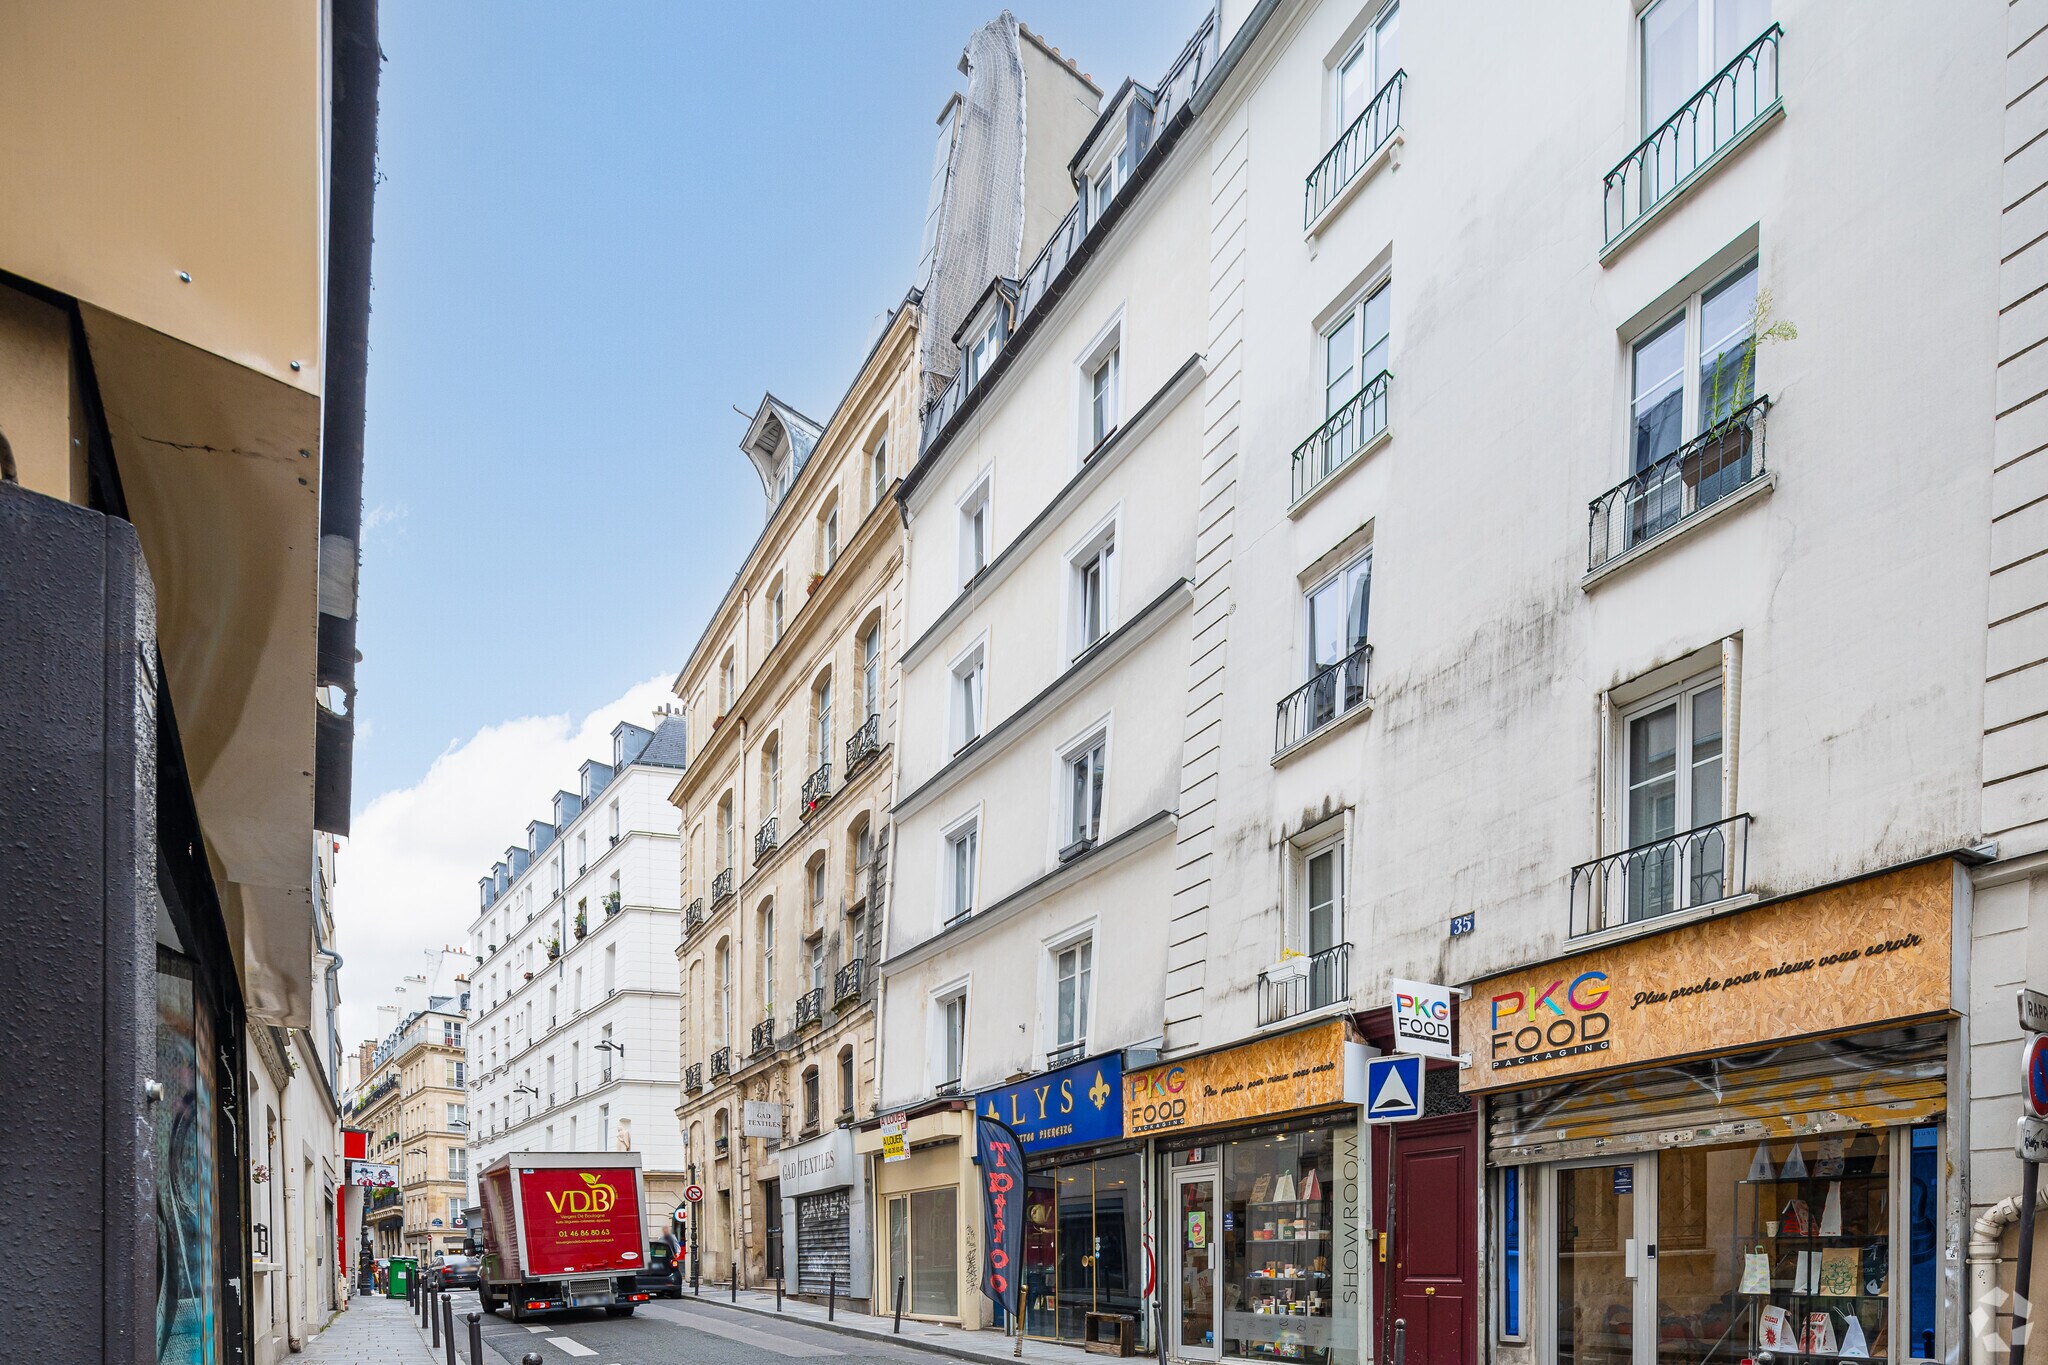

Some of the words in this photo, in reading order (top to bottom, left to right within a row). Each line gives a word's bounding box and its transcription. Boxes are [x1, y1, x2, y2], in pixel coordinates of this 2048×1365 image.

[1454, 915, 1472, 935] 35
[1630, 991, 1667, 1010] Plus
[1669, 977, 1720, 1003] proche
[1722, 969, 1761, 991] pour
[1763, 958, 1815, 980] mieux
[1818, 949, 1861, 967] vous
[1864, 933, 1922, 957] servir
[1397, 993, 1448, 1020] PKG
[1492, 971, 1610, 1031] PKG
[1399, 1017, 1449, 1037] FOOD
[1492, 1012, 1610, 1059] FOOD
[1492, 1041, 1609, 1069] PACKAGING
[1131, 1066, 1185, 1101] PKG
[1011, 1079, 1074, 1126] LYS
[1131, 1098, 1186, 1126] FOOD
[748, 1120, 781, 1128] TEXTILES
[887, 1111, 906, 1124] LOUER
[1132, 1119, 1185, 1132] PACKAGING
[887, 1134, 904, 1146] LOUER
[782, 1162, 796, 1181] GAD
[798, 1150, 835, 1177] TEXTILES
[545, 1190, 610, 1213] VDB
[1343, 1134, 1358, 1305] SHOWROOM
